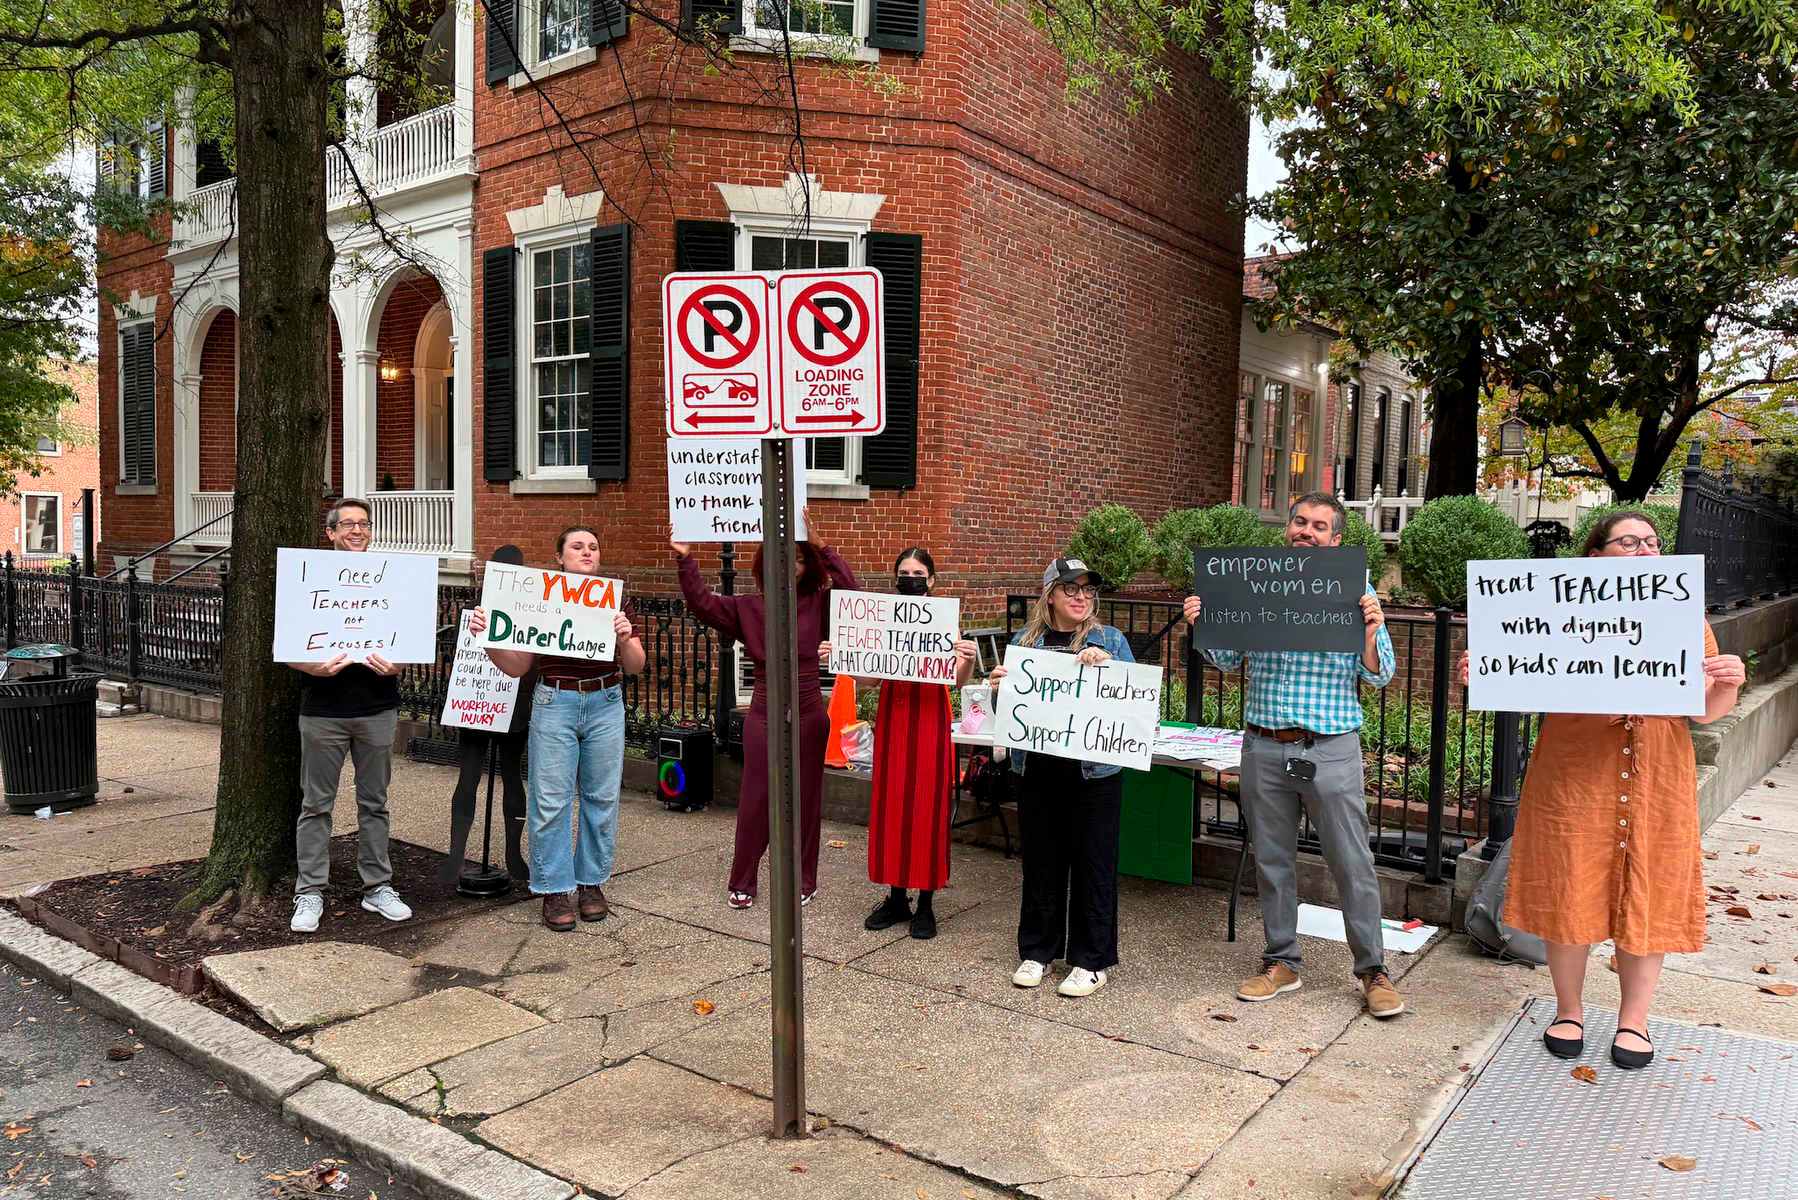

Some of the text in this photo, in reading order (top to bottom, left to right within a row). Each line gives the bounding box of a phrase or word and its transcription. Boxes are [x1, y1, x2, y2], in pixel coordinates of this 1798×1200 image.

[702, 300, 743, 353] P
[812, 297, 853, 350] P
[795, 368, 864, 383] LOADING
[808, 384, 852, 397] ZONE
[671, 447, 762, 465] understaf
[675, 496, 696, 510] no
[701, 494, 754, 511] thank
[301, 560, 388, 584] I need
[1206, 556, 1312, 581] empower
[492, 569, 617, 610] The YWCA
[1250, 578, 1343, 596] women
[1475, 572, 1691, 605] treat TEACHERS
[309, 589, 390, 611] TEACHERS
[514, 601, 563, 616] needs a
[838, 597, 933, 624] MORE KIDS
[344, 615, 365, 625] not
[1202, 607, 1353, 625] listen to teachers
[558, 618, 606, 659] Change
[837, 625, 954, 653] FEWER TEACHERS
[1501, 616, 1643, 646] with dignity
[457, 662, 483, 675] could
[829, 650, 957, 680] WHAT COULD GO WRONG?
[1508, 652, 1558, 677] kids
[1566, 660, 1604, 675] can
[1613, 649, 1687, 687] learn!
[455, 676, 513, 693] be here due
[1013, 658, 1158, 703] Support Teachers
[451, 699, 508, 714] WORKPLACE
[475, 691, 486, 701] to
[461, 711, 495, 726] INJURY
[1008, 703, 1149, 757] Support Children
